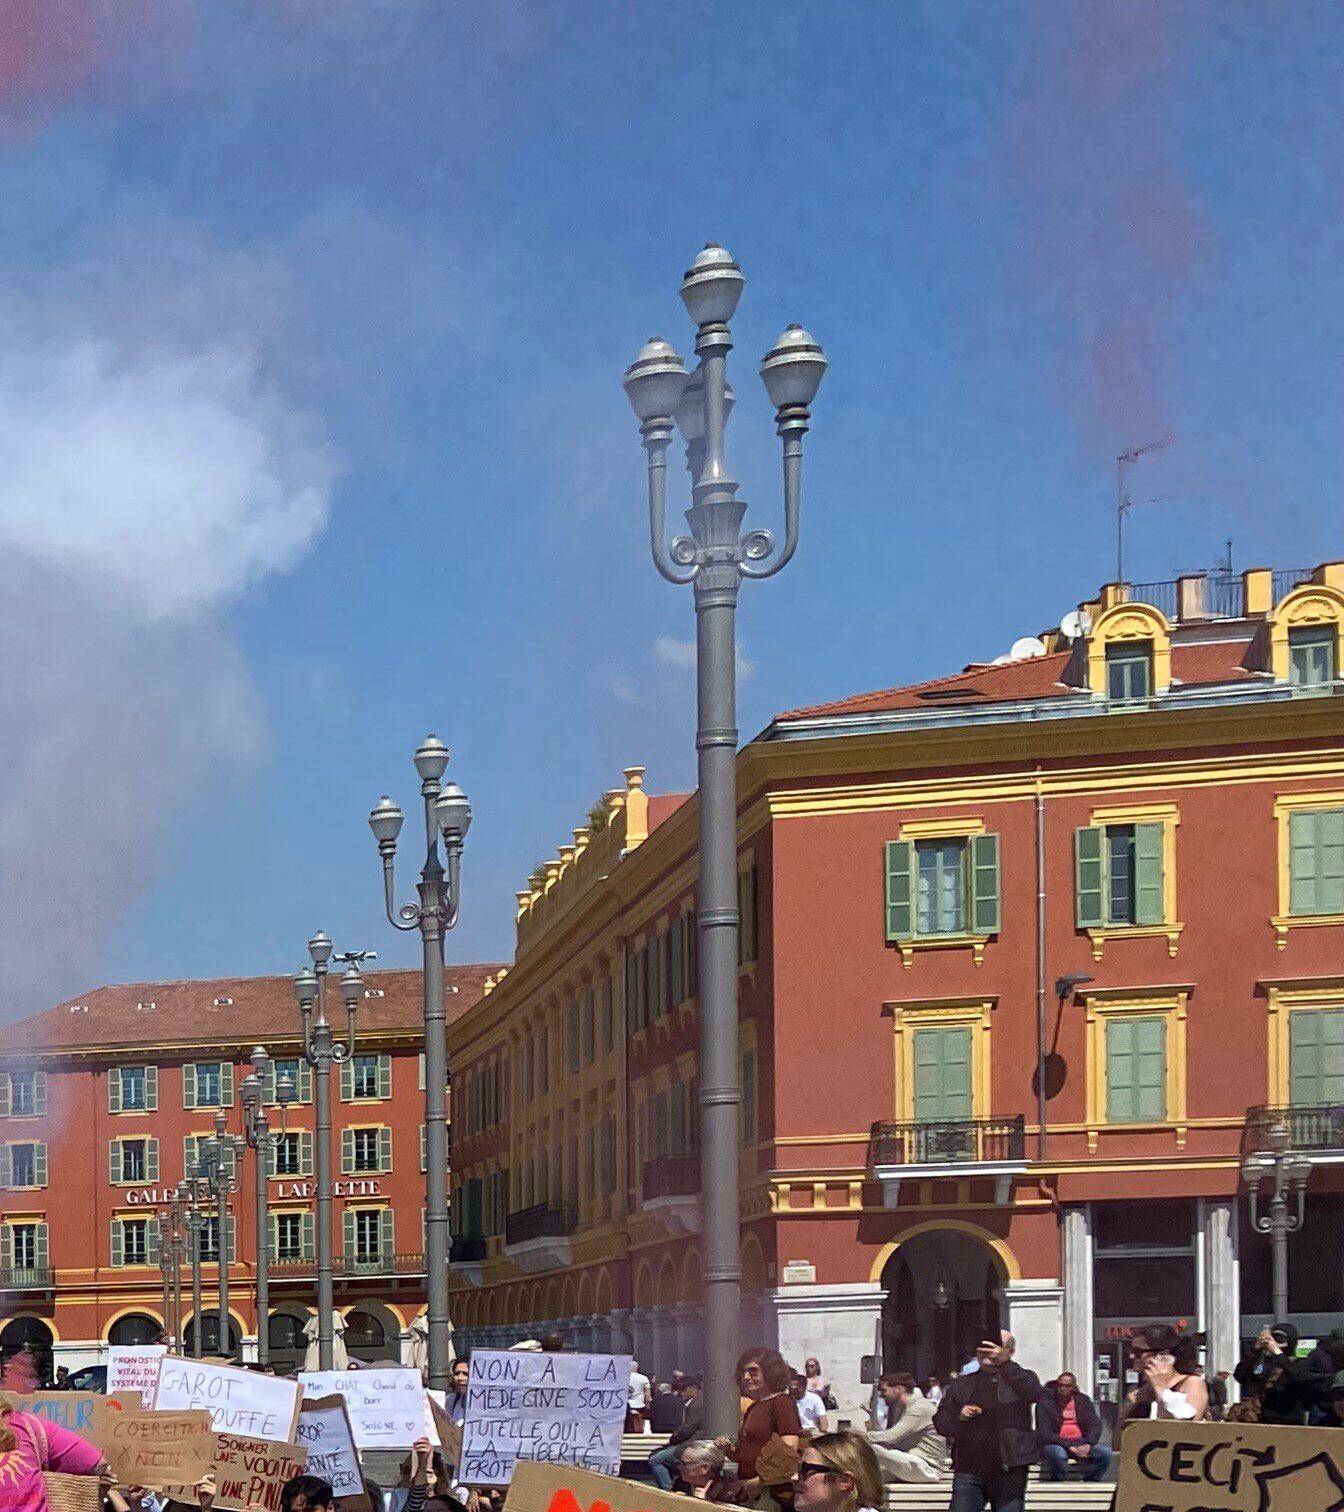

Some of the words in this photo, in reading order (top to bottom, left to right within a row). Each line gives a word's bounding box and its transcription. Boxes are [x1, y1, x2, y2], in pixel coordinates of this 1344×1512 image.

[472, 1359, 520, 1381] NON
[541, 1356, 556, 1383] À
[584, 1358, 617, 1382] LA
[162, 1368, 244, 1401] GAROT
[578, 1386, 625, 1410] SOUS
[464, 1439, 498, 1459] LA
